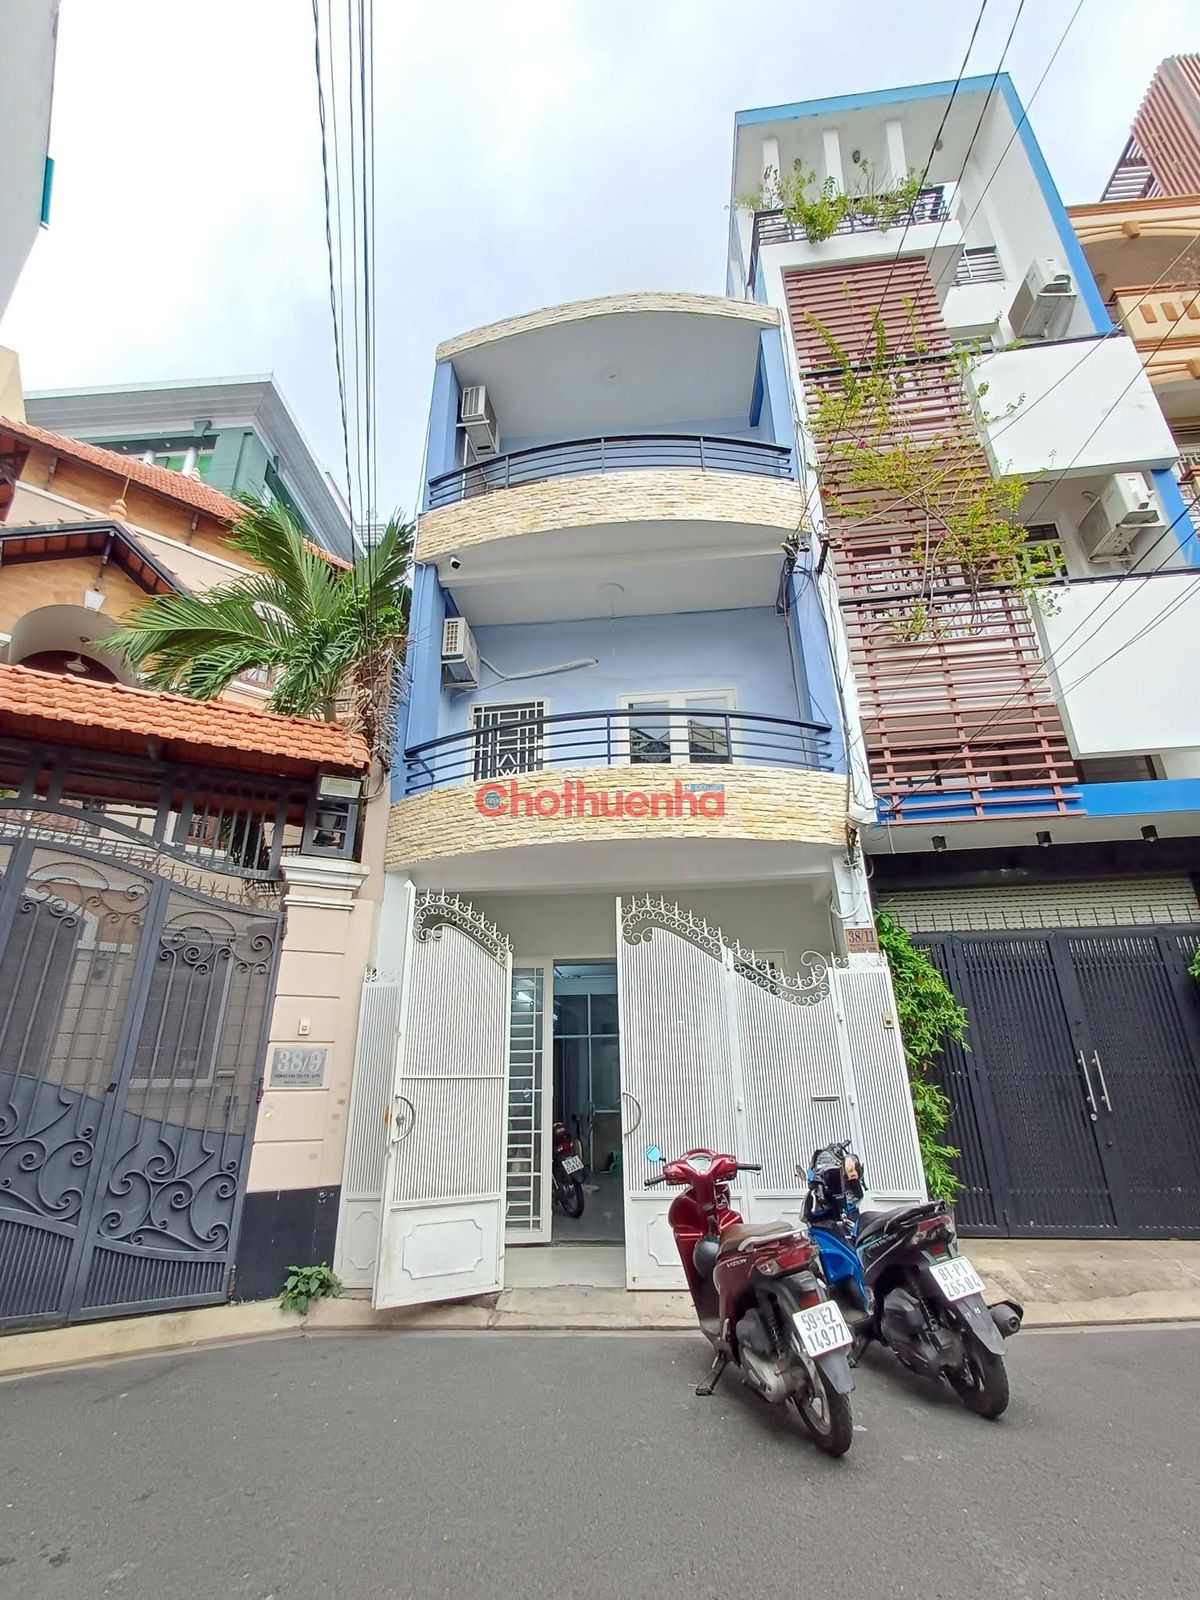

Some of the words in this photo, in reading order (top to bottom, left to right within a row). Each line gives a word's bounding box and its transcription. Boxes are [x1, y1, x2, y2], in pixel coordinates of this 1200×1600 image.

[277, 1051, 322, 1072] 38/9
[801, 1307, 836, 1331] 59-E2
[807, 1323, 845, 1351] 149.77
